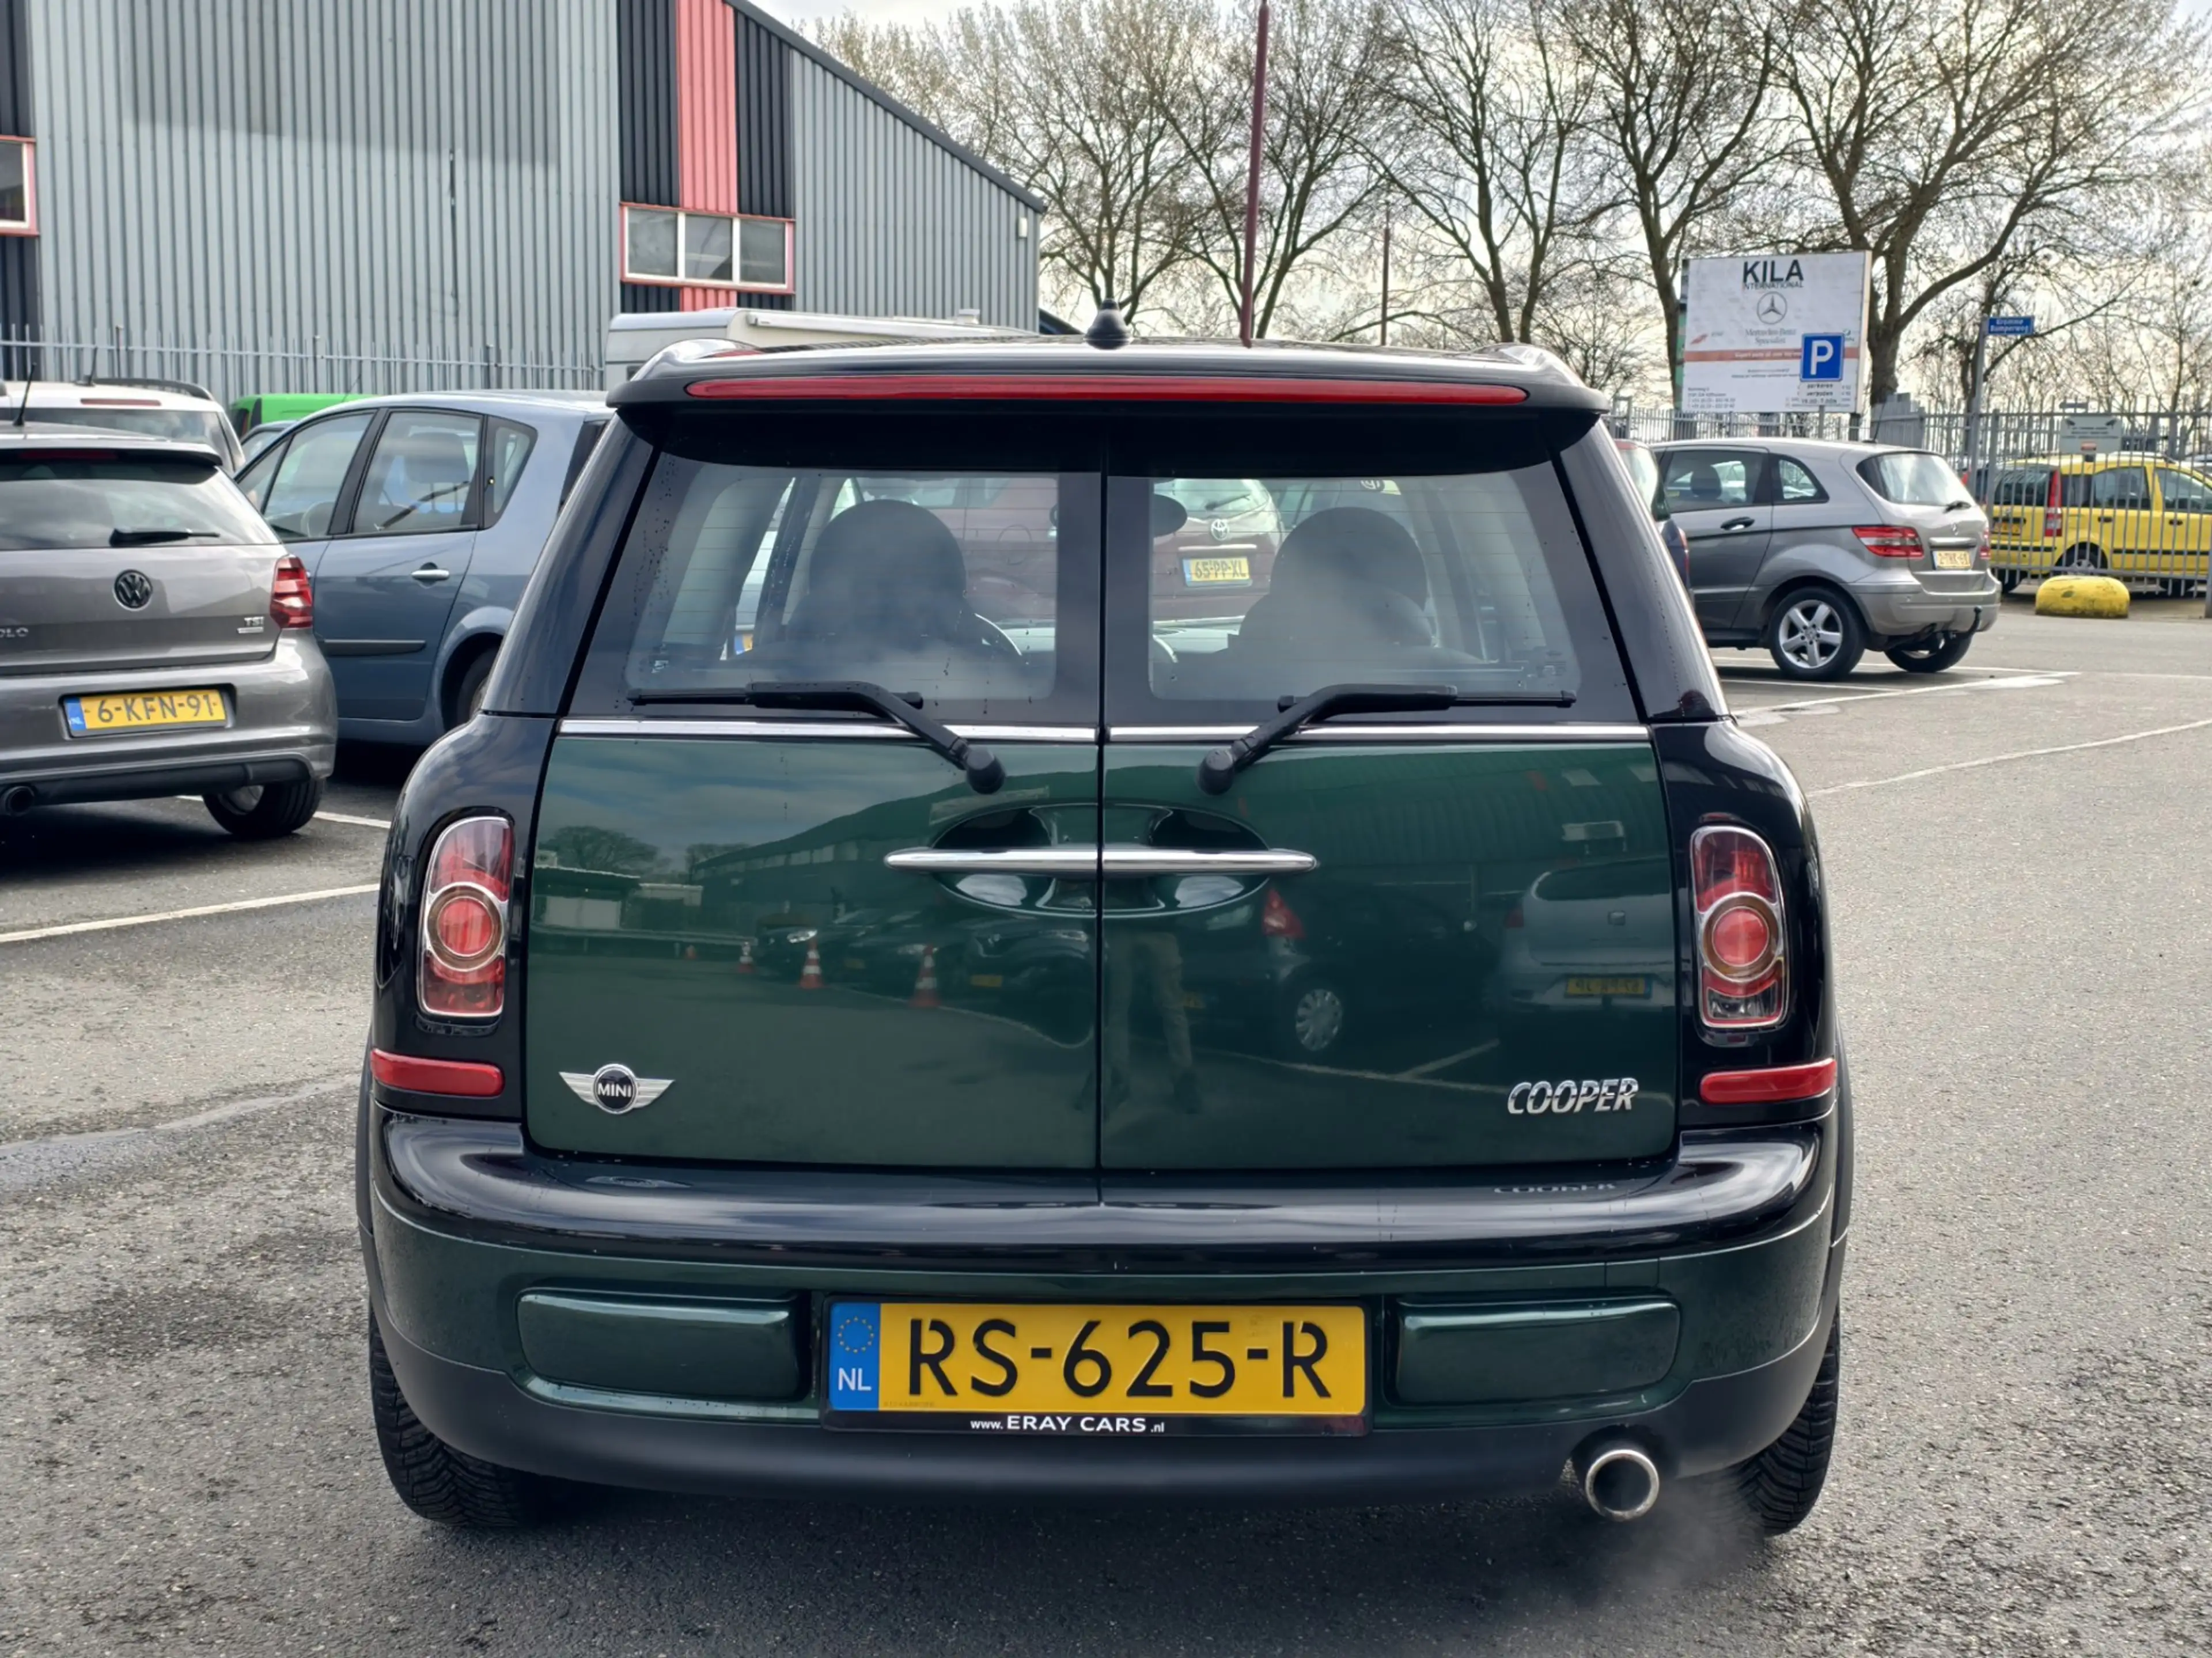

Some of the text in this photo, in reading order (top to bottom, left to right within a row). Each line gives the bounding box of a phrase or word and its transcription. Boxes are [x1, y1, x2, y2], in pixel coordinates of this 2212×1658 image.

[1743, 259, 1804, 283] KILA
[1810, 340, 1834, 375] P
[1195, 560, 1246, 578] 65-PP-XL
[98, 695, 214, 723] 6-KFN-91
[598, 1083, 632, 1098] MINI
[1508, 1077, 1639, 1114] COOPER
[838, 1318, 1332, 1399] NL RS-625-R
[1007, 1415, 1071, 1431] ERAY
[1080, 1417, 1146, 1432] CARS
[1150, 1422, 1165, 1433] .nl
